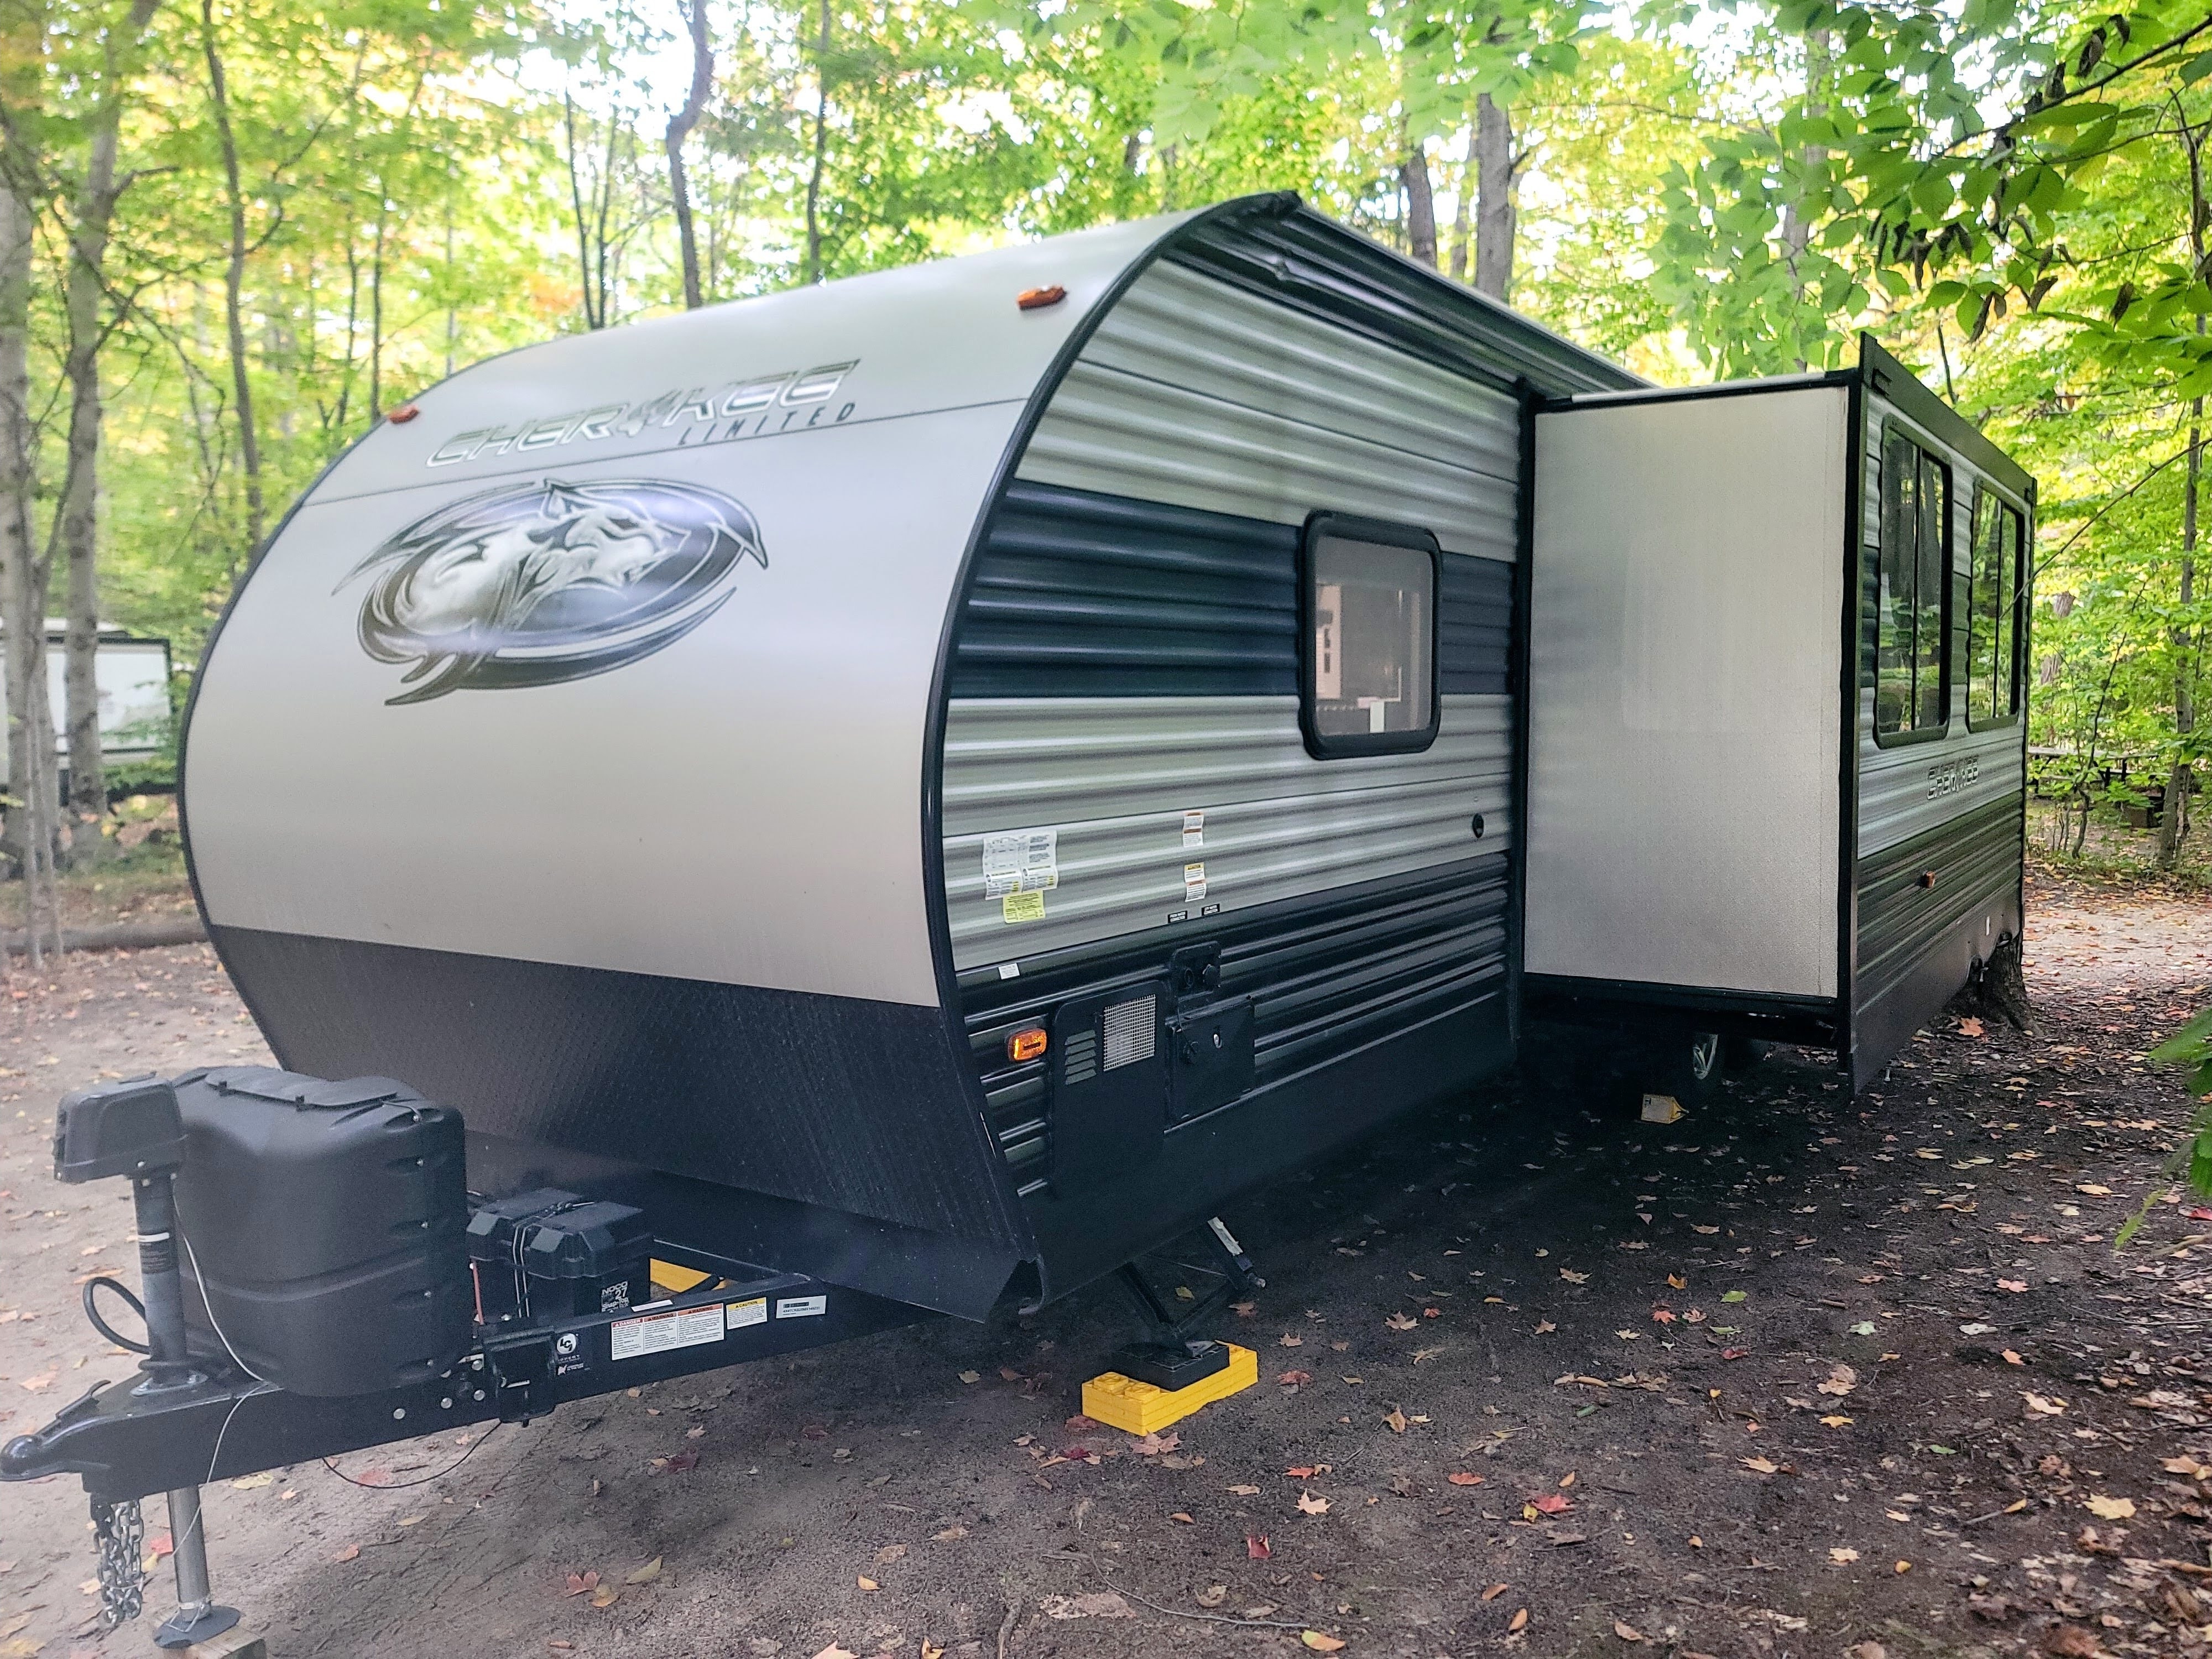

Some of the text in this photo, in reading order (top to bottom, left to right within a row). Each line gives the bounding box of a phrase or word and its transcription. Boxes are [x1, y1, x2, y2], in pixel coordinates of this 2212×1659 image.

[426, 358, 861, 468] CHERKEE
[678, 403, 855, 445] LIMITED
[1927, 755, 1979, 800] CHERKEE
[602, 1281, 628, 1295] NOCO
[615, 1286, 628, 1300] 27
[619, 1318, 641, 1327] DANGER
